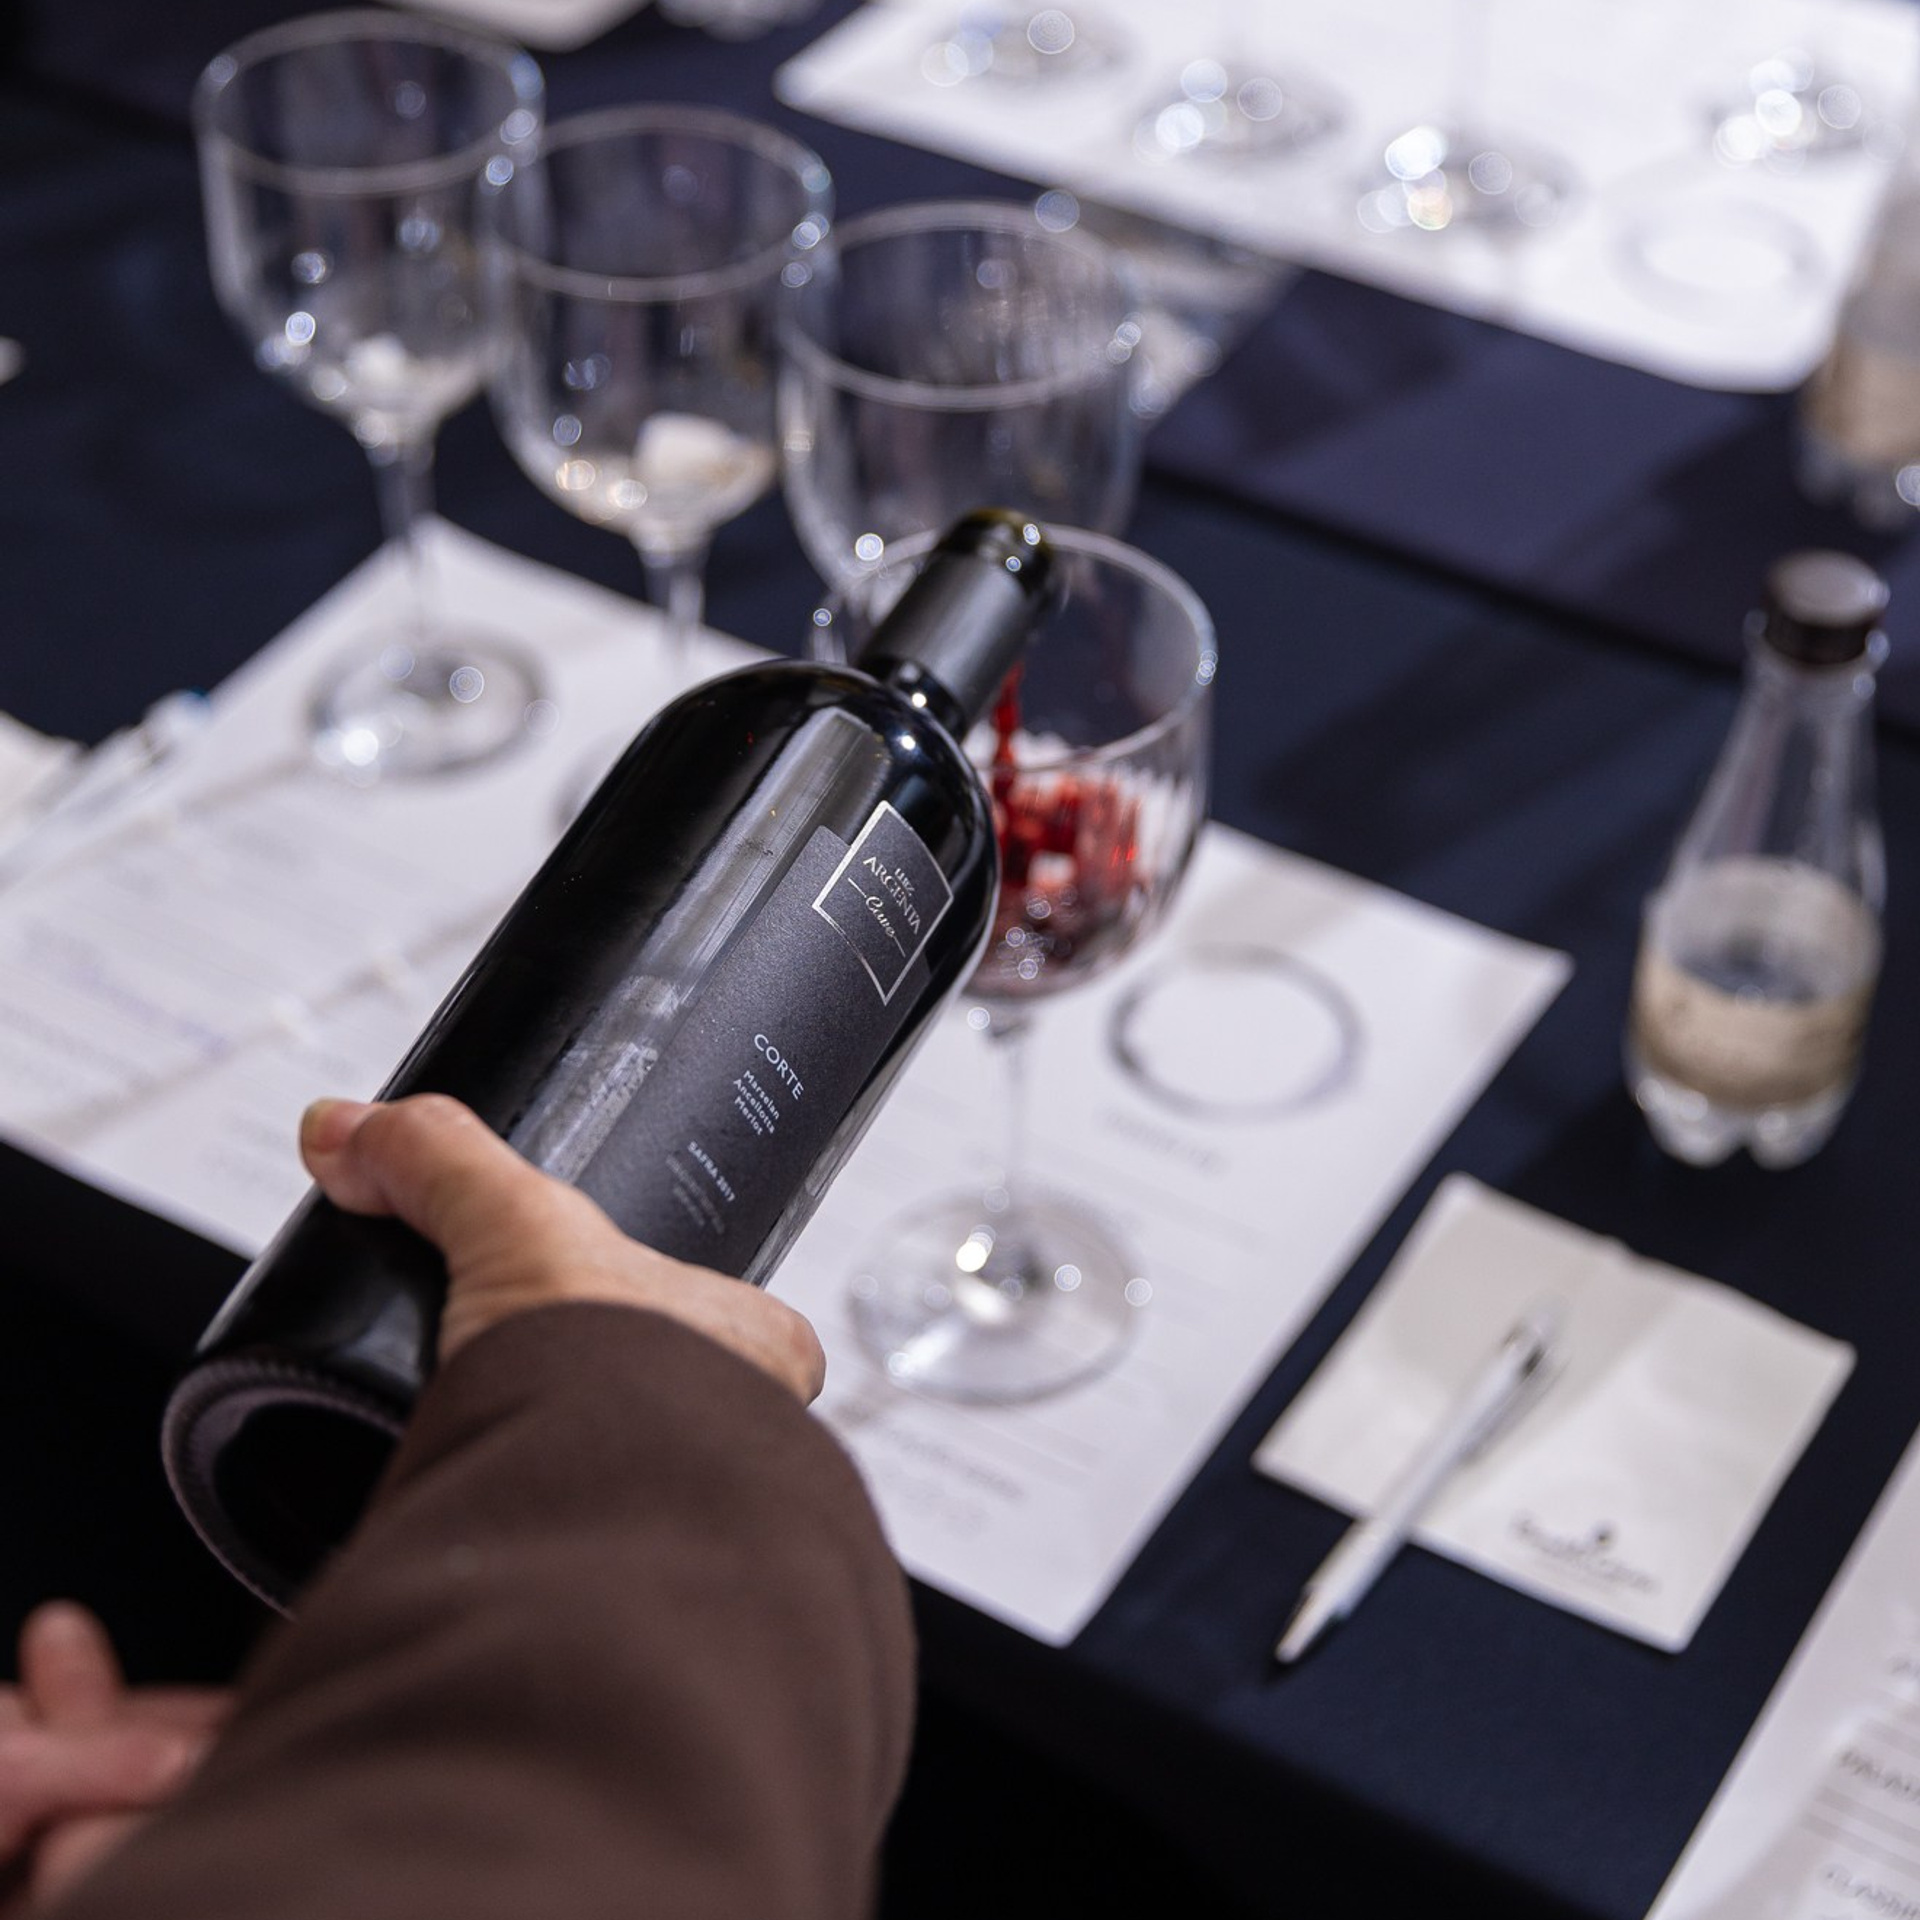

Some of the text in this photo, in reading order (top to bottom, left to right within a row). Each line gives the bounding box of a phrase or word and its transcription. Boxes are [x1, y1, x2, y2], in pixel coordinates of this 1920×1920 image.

[863, 856, 921, 935] ARGENTA
[754, 1034, 804, 1100] CORTE
[733, 1078, 775, 1134] Ancellotta
[734, 1096, 763, 1135] Merlot
[743, 1070, 780, 1120] Marselan
[687, 1141, 718, 1179] SAFRA
